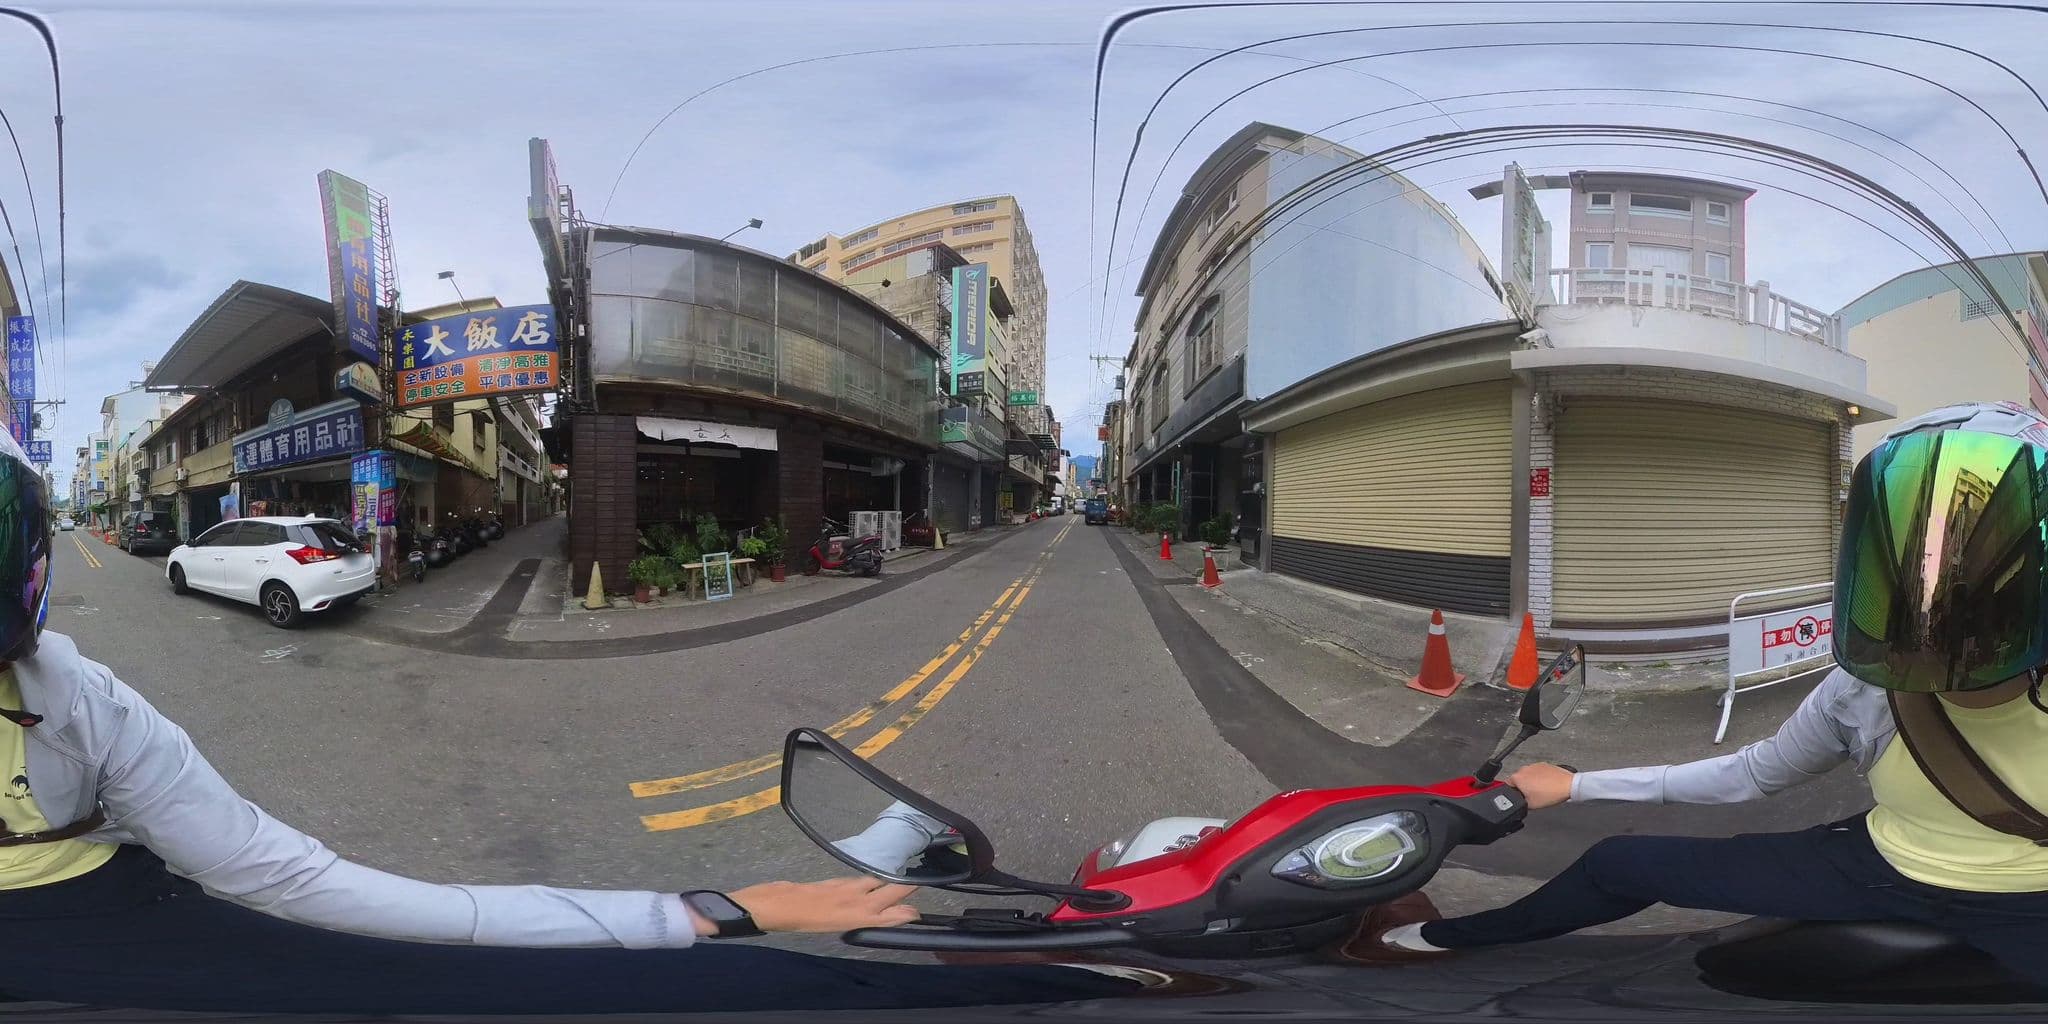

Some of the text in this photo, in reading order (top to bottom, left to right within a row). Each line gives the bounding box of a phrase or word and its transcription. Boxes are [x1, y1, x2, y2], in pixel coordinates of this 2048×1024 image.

[421, 311, 550, 361] 大飯店
[404, 353, 549, 387] 全新設備 清淨高雅
[404, 380, 465, 402] 停車安全
[479, 371, 549, 389] 平價優惠
